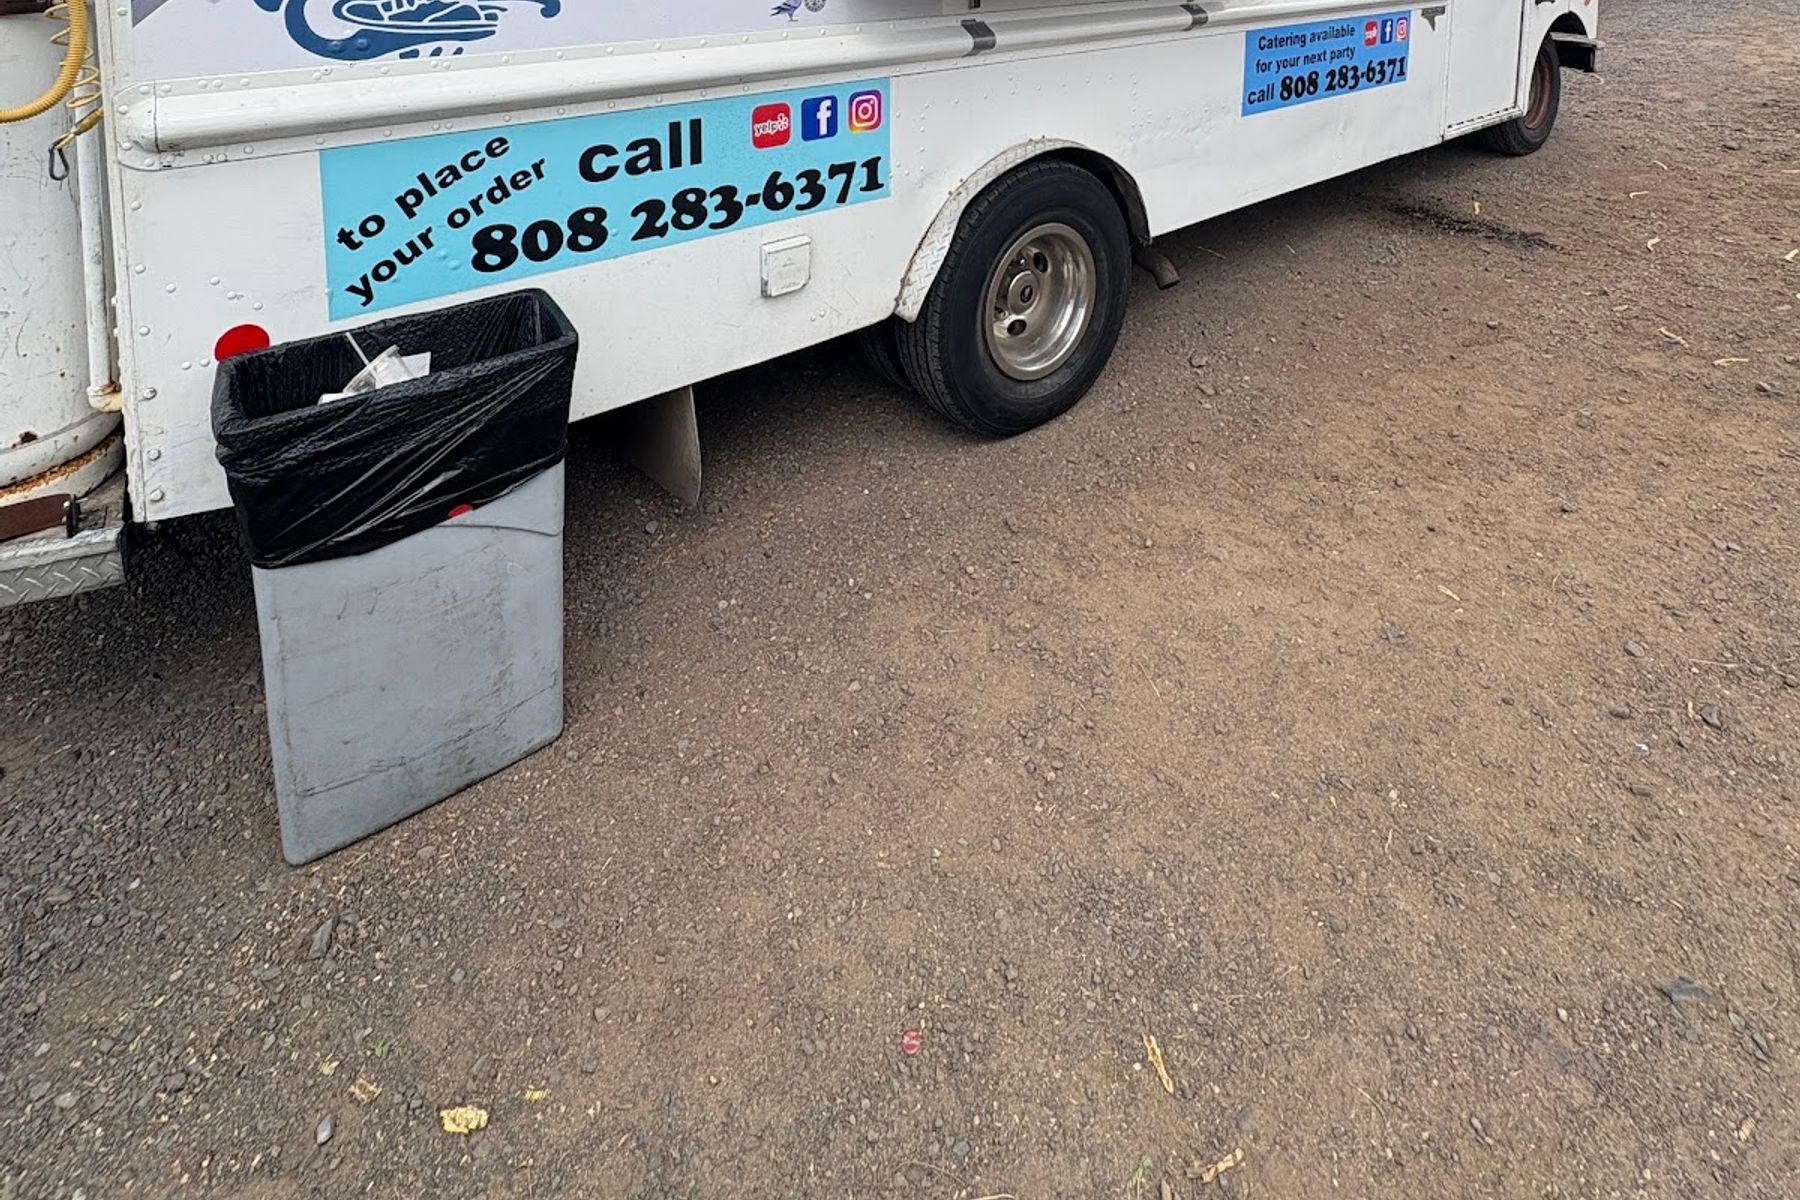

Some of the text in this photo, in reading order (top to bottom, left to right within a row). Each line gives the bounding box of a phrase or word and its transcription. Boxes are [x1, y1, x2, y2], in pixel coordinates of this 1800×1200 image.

[1255, 45, 1356, 74] for your next party
[1258, 33, 1307, 51] Catering
[1309, 24, 1356, 43] available
[1247, 56, 1407, 105] call 808 283-6371
[578, 118, 703, 183] call
[337, 135, 511, 252] to place
[471, 155, 885, 273] 808 283-6371
[345, 157, 547, 307] your order
